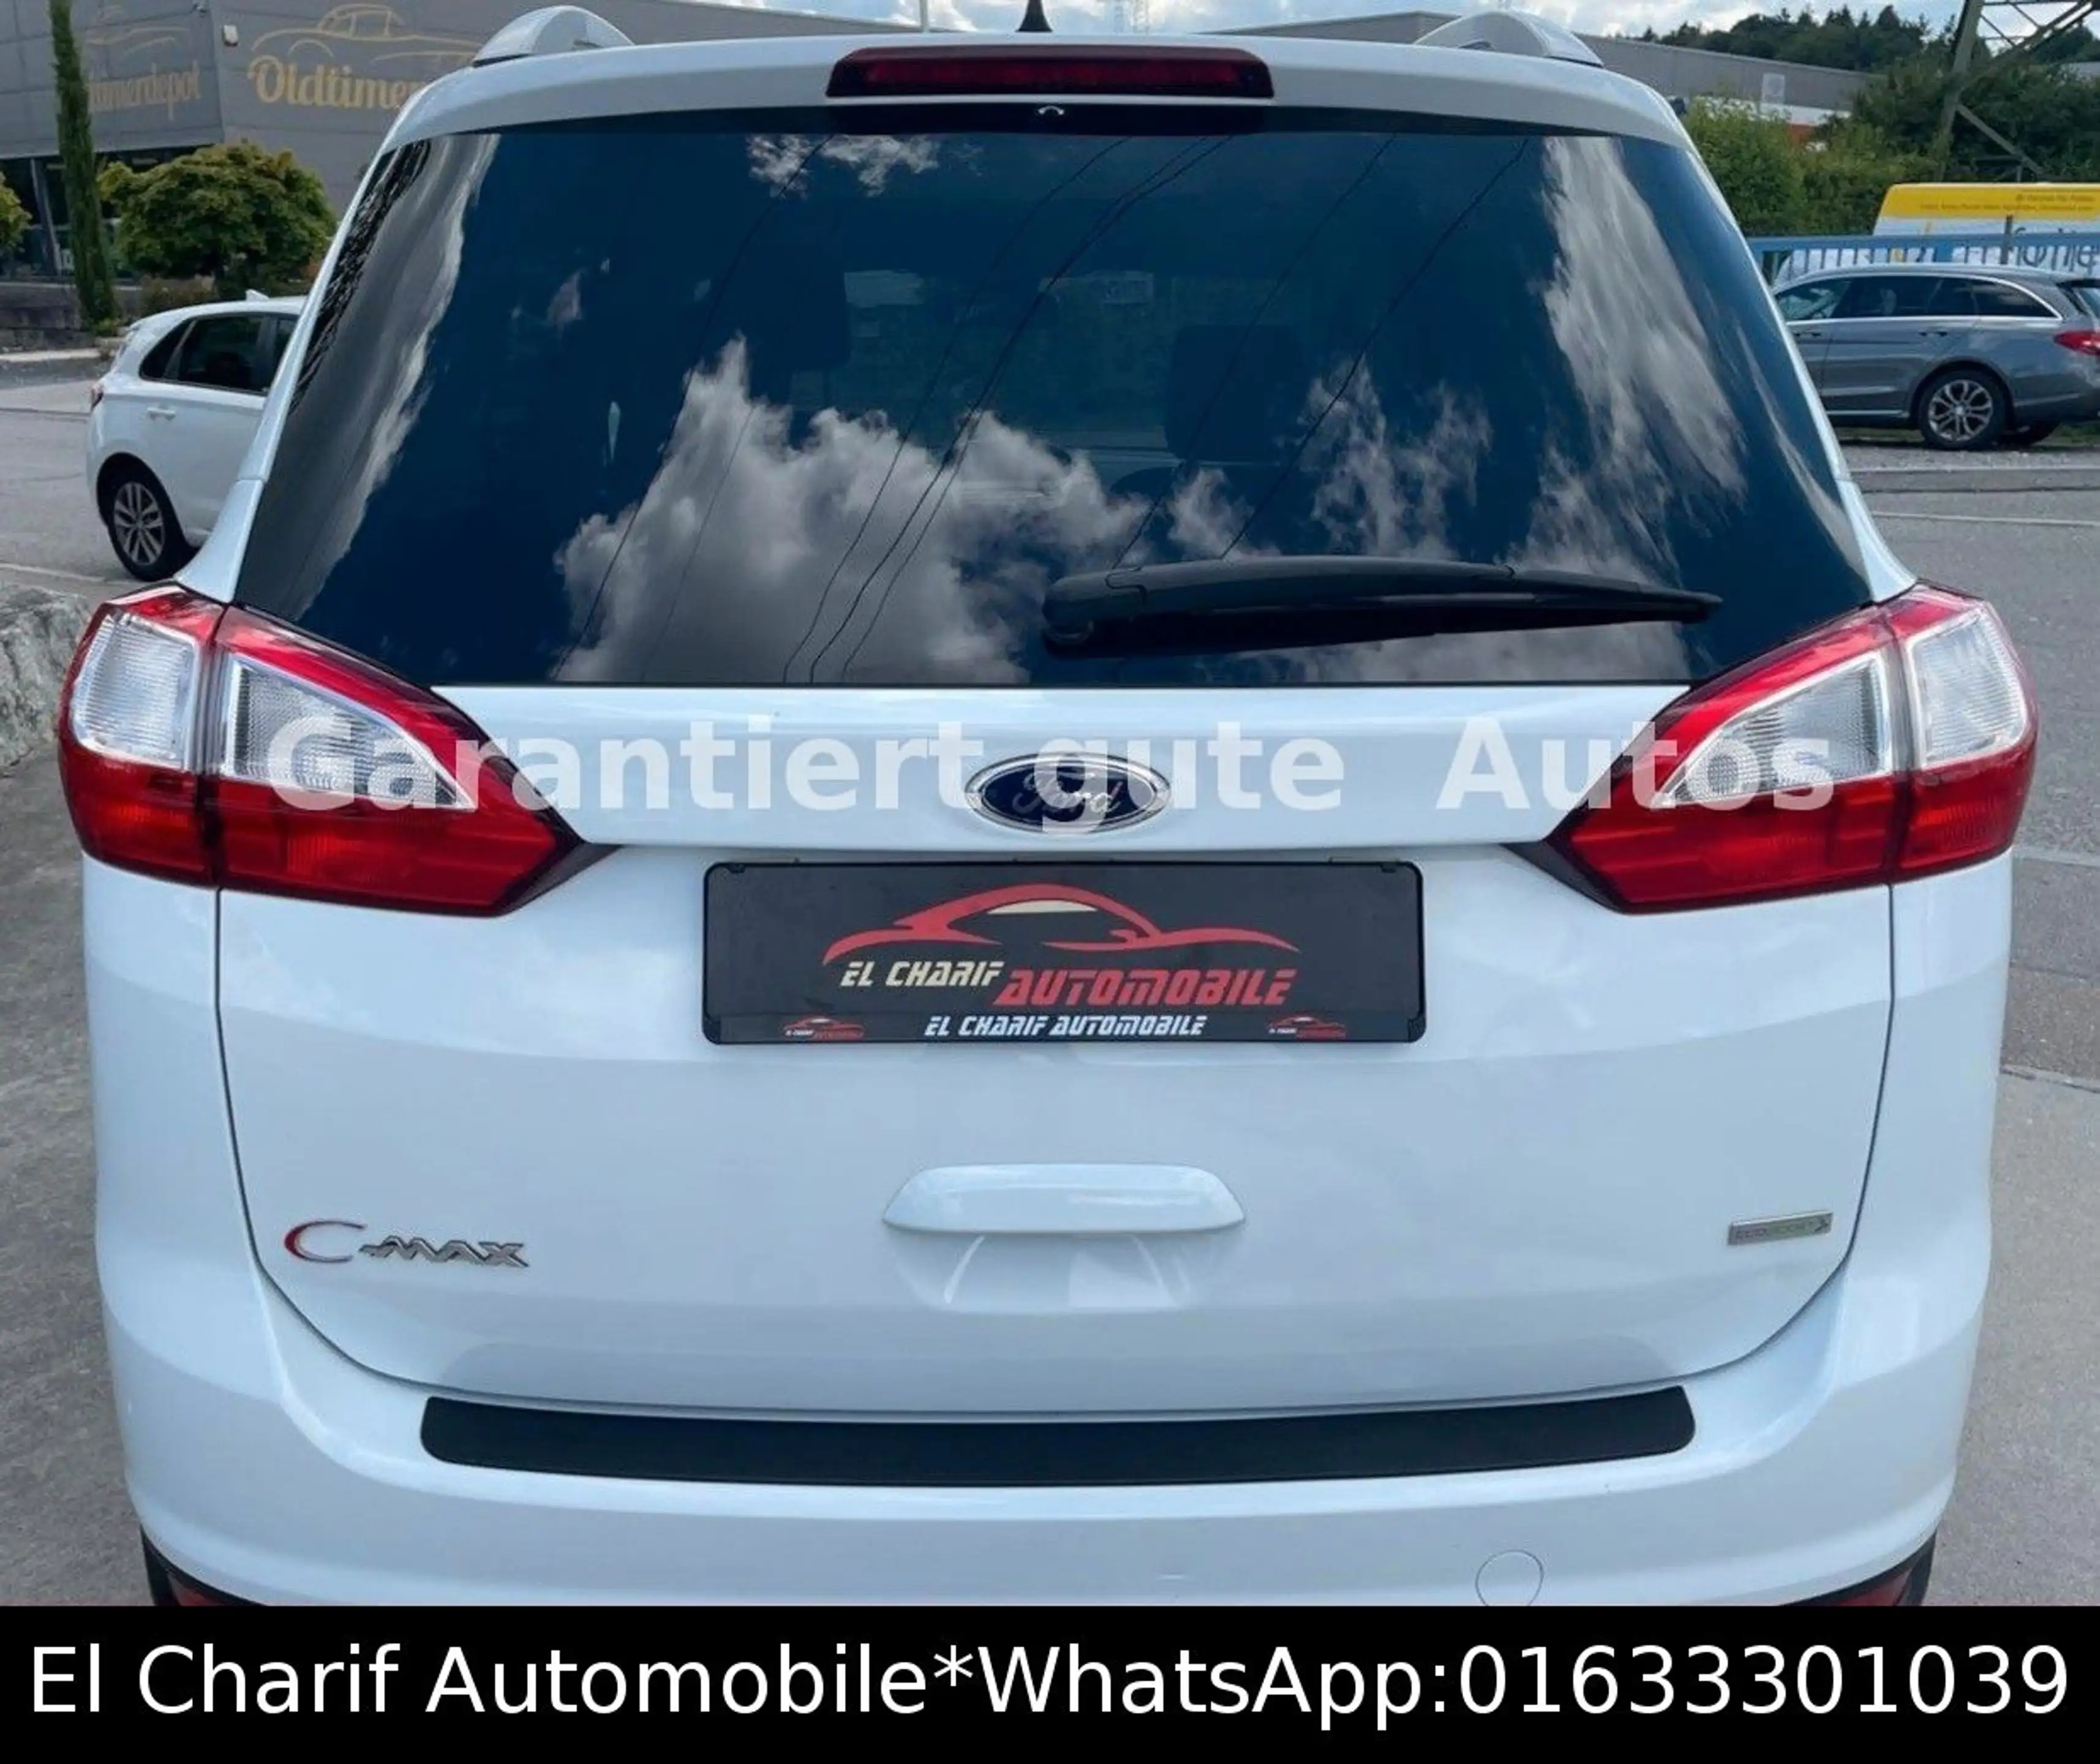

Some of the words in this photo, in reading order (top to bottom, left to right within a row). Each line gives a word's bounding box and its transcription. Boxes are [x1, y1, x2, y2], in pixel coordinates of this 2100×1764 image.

[840, 961, 876, 987] EL
[885, 961, 1005, 987] CHARIF
[992, 968, 1297, 1006] AUTOMOBILE
[924, 1015, 951, 1036] EL
[958, 1015, 1049, 1036] CHARIF
[1048, 1014, 1208, 1036] AUTOMOBILE
